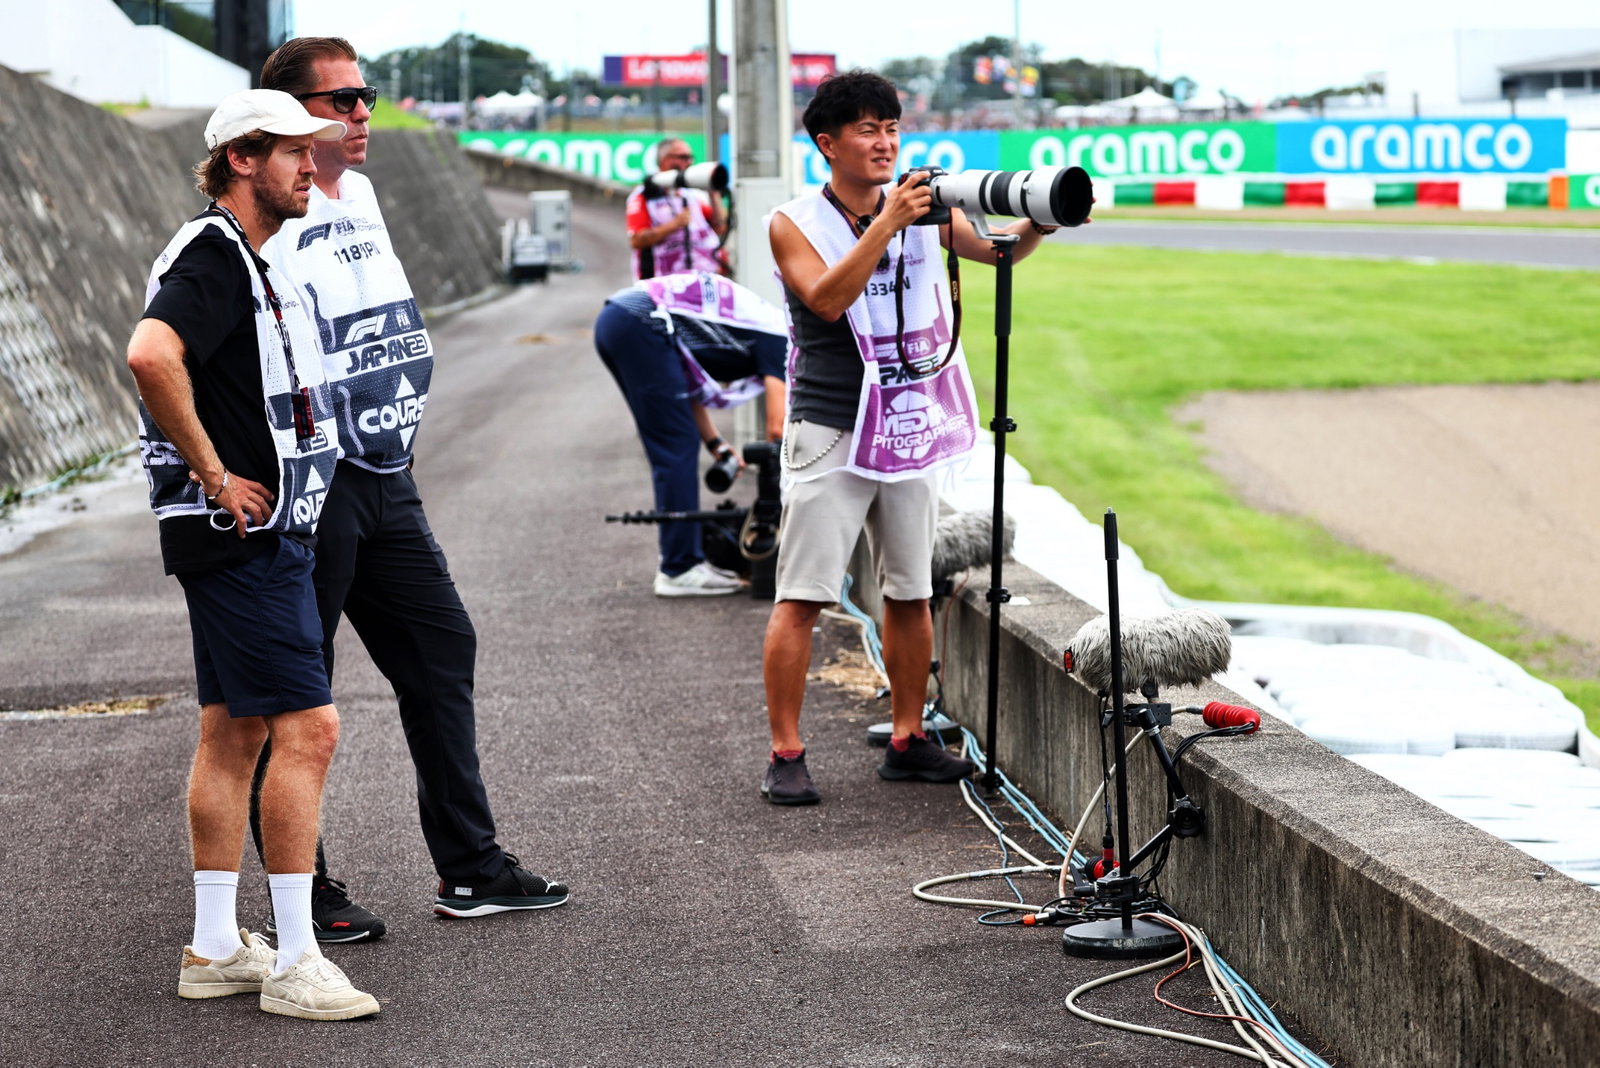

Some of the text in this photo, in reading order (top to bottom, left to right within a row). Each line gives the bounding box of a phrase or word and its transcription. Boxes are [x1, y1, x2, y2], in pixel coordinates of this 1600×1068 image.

[1029, 128, 1245, 176] aramco
[1310, 123, 1533, 170] aramco
[907, 341, 930, 356] FIA
